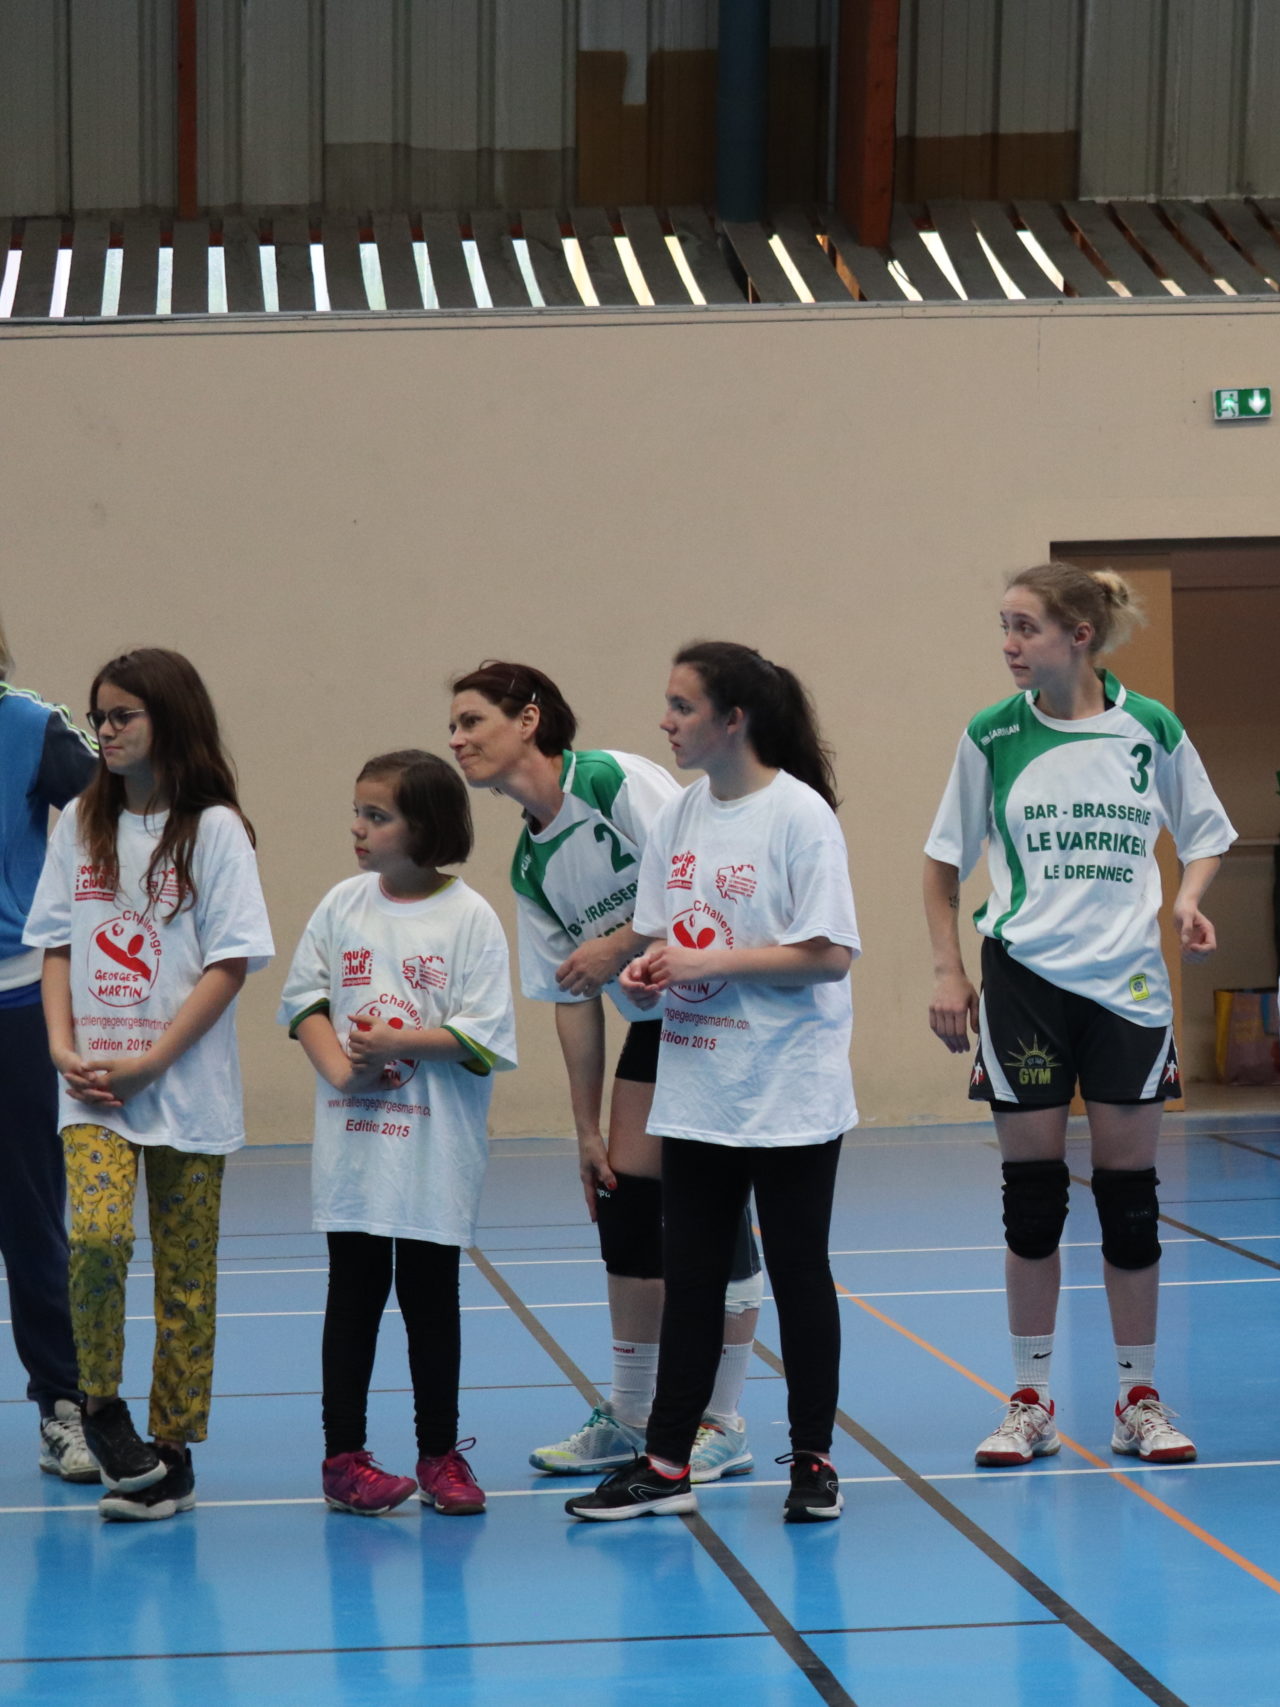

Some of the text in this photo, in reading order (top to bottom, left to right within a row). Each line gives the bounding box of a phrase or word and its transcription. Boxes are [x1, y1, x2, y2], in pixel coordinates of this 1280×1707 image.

[1130, 743, 1152, 794] 3
[1024, 804, 1058, 820] BAR
[1072, 803, 1152, 826] BRASSERIE
[593, 823, 637, 874] 2
[1026, 832, 1052, 853] LE
[1044, 864, 1134, 883] LE DRENNEC
[95, 969, 142, 982] GEORGES
[98, 985, 142, 999] MARTIN
[126, 1038, 153, 1051] 2015
[691, 1036, 717, 1050] 2015
[1018, 1067, 1051, 1085] GYM
[381, 1122, 411, 1137] 2015
